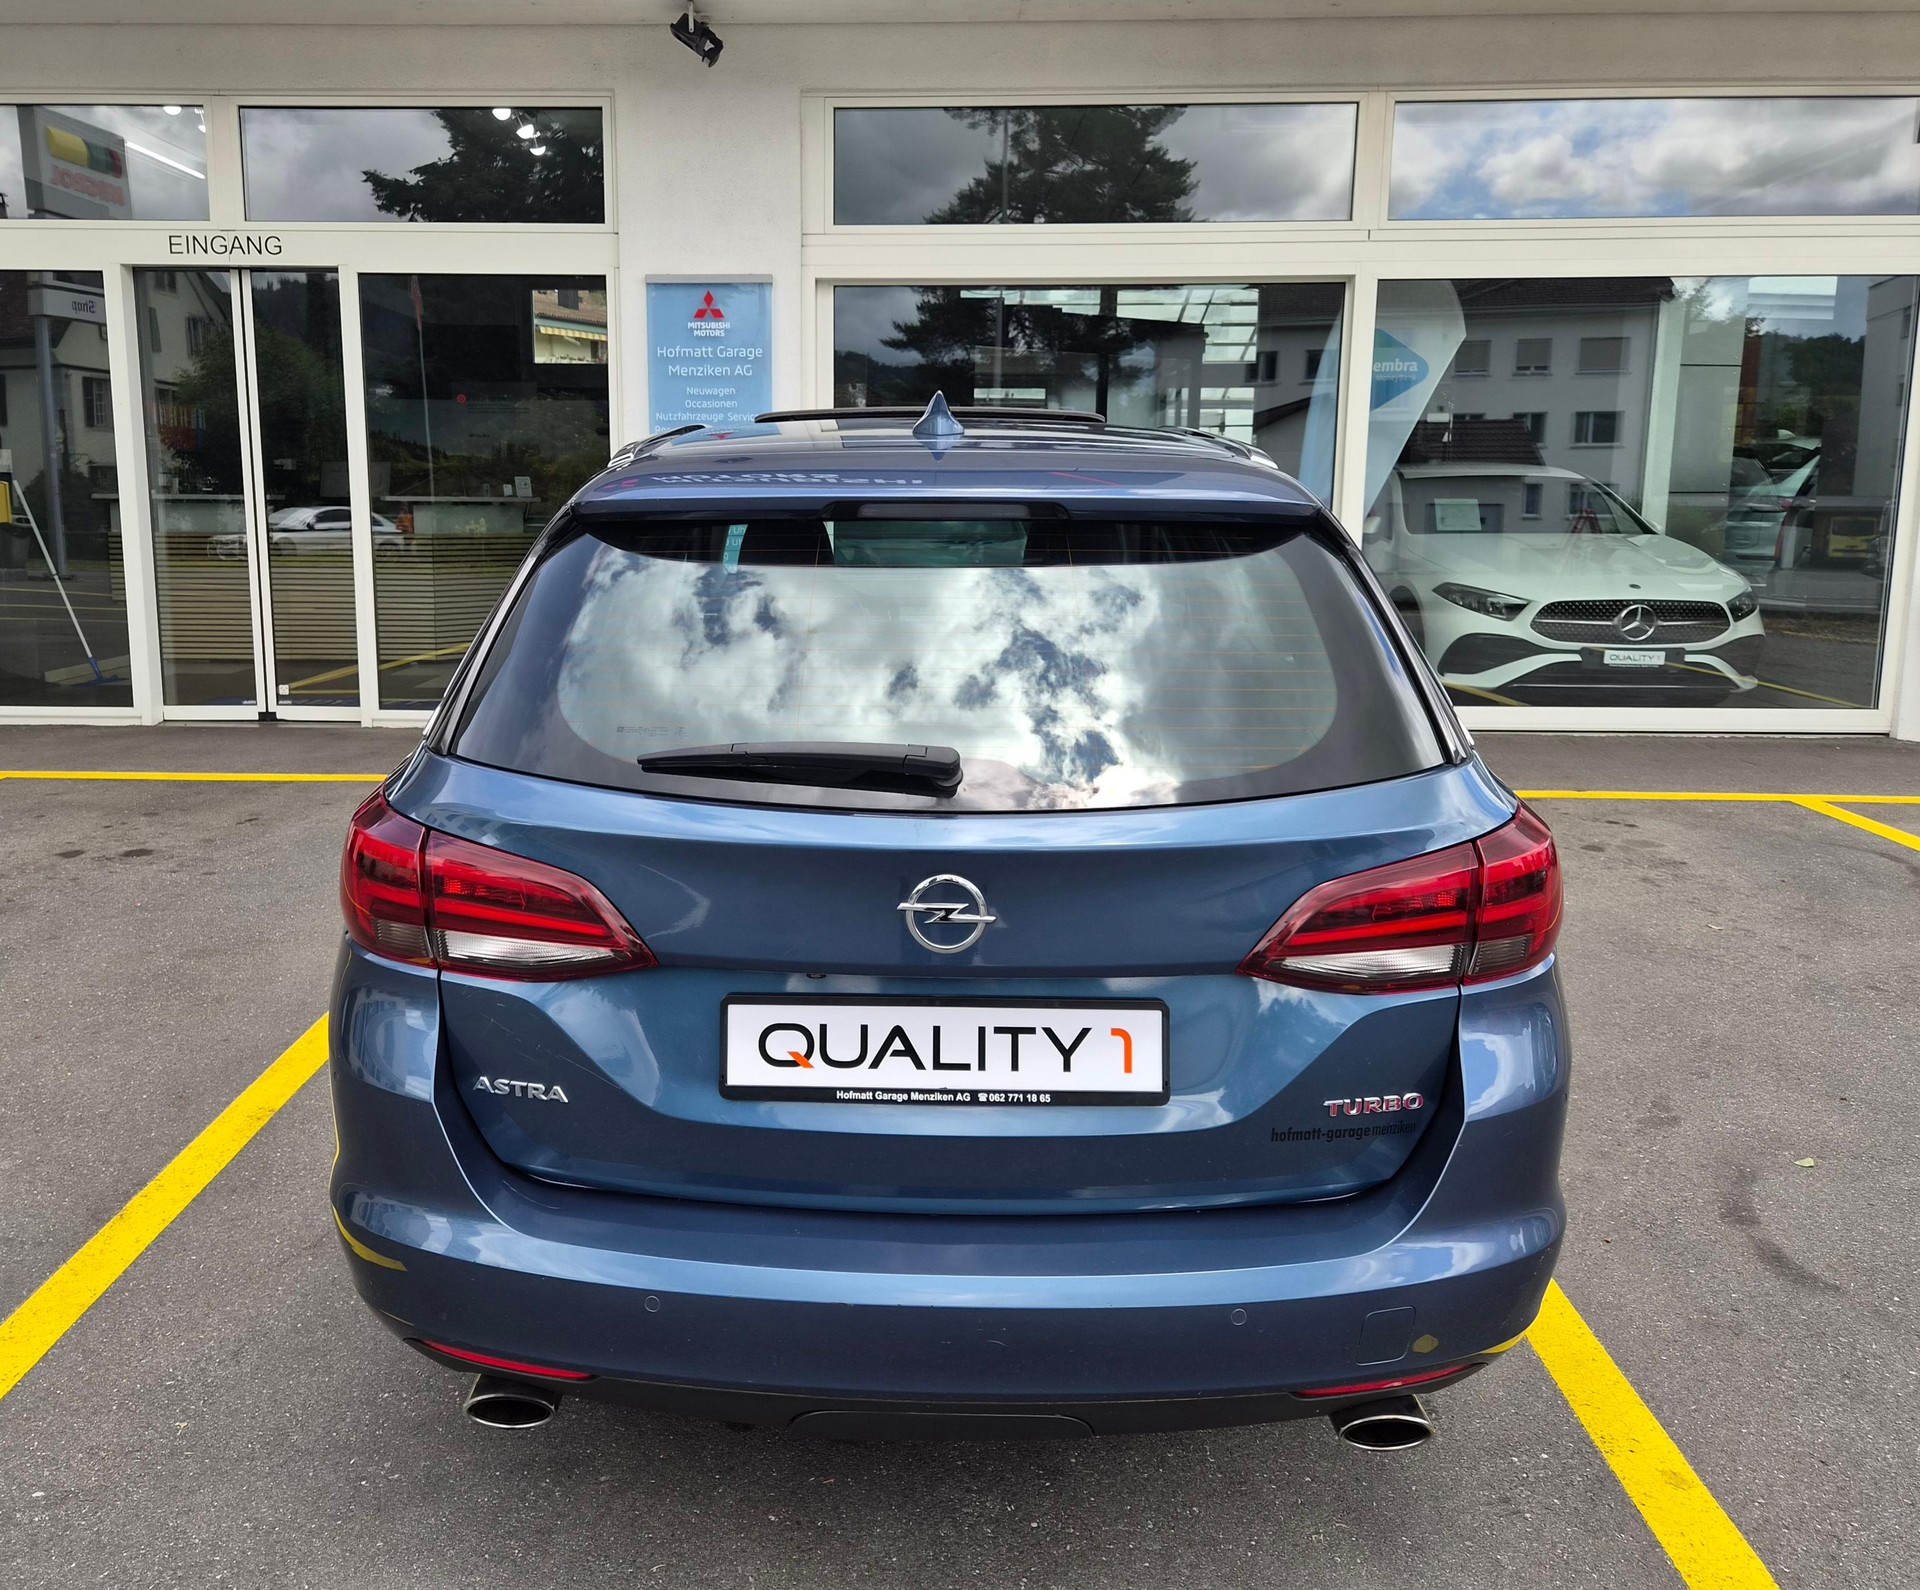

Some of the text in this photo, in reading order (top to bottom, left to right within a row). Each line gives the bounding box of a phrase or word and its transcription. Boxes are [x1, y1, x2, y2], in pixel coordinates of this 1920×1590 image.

[168, 235, 283, 255] EINGANG
[657, 345, 763, 360] Hofmatt Garage
[668, 364, 753, 377] Menziken AG
[686, 386, 736, 396] Neuwagen
[684, 399, 738, 409] Occasionen
[655, 412, 757, 423] Nutzfahrzeuge Servic
[1609, 654, 1654, 662] QUALITY
[757, 1022, 1133, 1074] QUALITY 1
[472, 1076, 569, 1103] ASTRA
[836, 1090, 1051, 1103] Hofmatt Garage Menziken AG 062 771 18 65
[1322, 1092, 1424, 1117] TURBO
